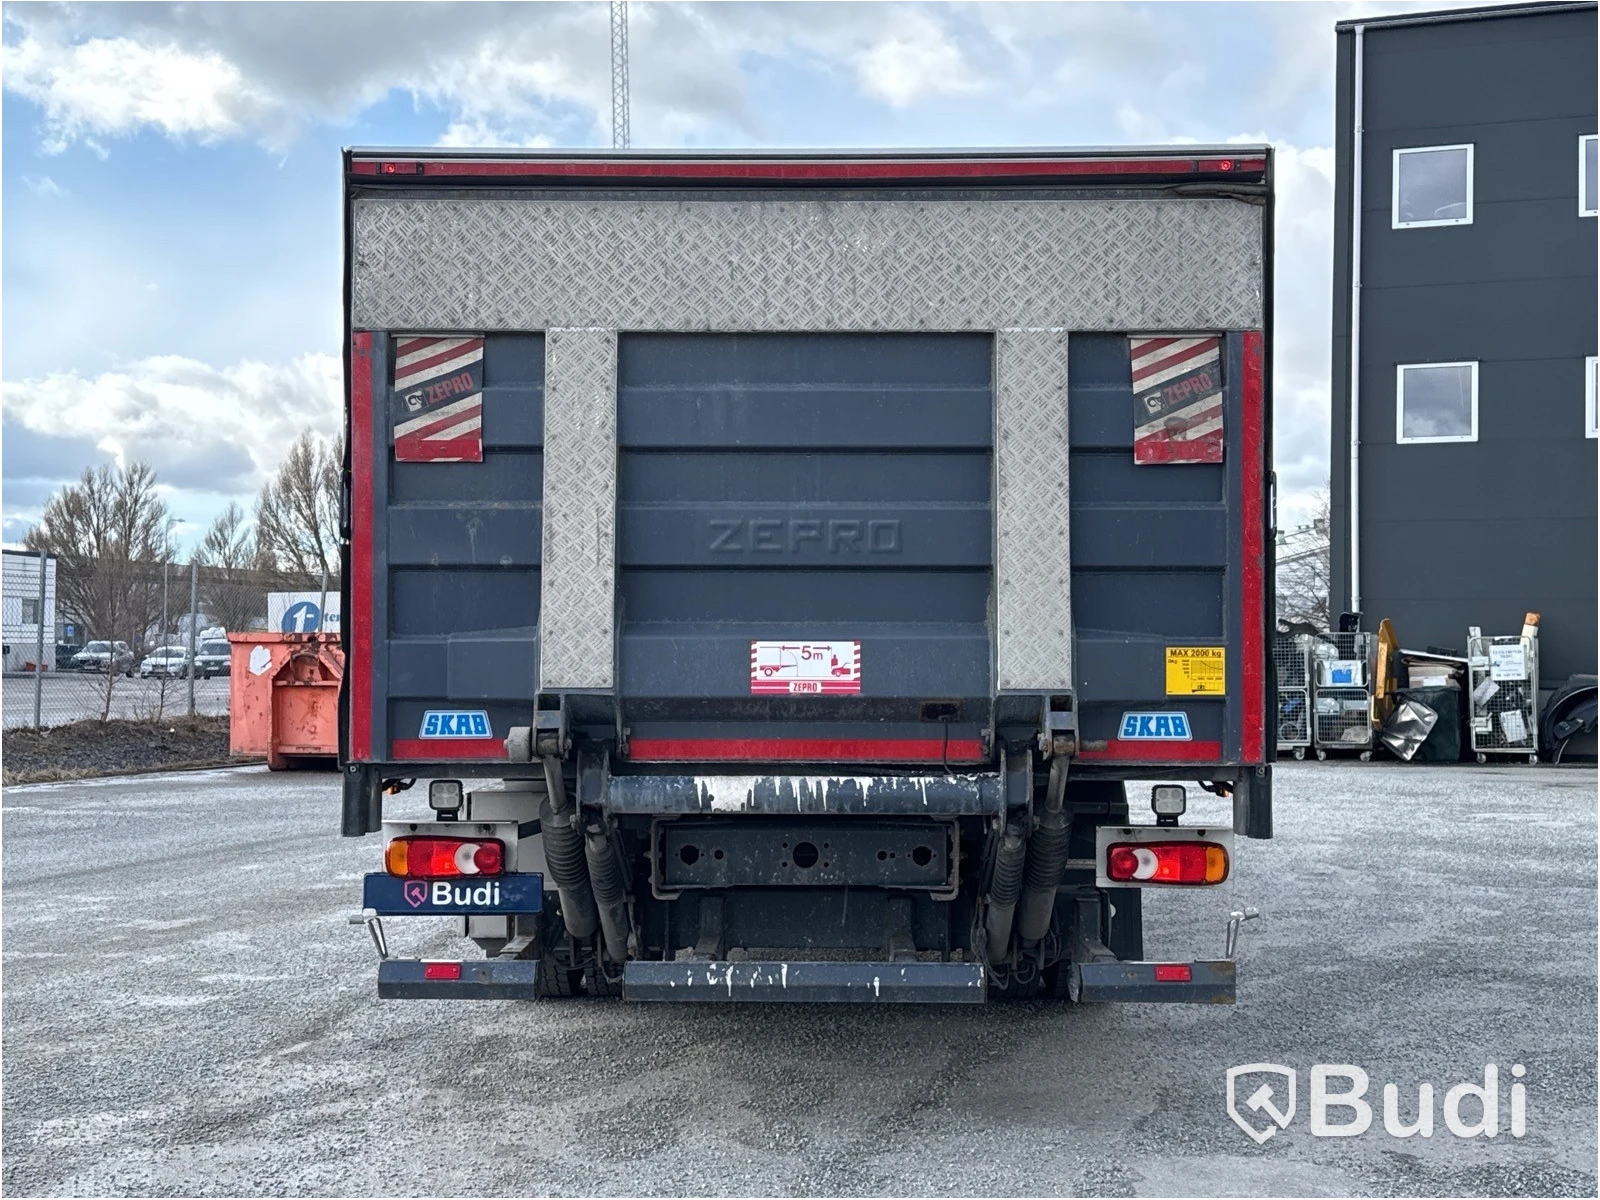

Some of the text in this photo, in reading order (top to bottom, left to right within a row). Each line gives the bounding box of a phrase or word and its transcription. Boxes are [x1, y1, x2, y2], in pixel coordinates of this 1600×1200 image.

[425, 372, 474, 404] ZEPRO
[1164, 372, 1214, 405] ZEPRO
[709, 519, 903, 553] ZEPRO
[1170, 649, 1222, 658] MAX 2000 kg
[793, 682, 818, 692] ZEPRO
[425, 714, 487, 735] SKAB
[1123, 716, 1187, 736] SKAB
[432, 881, 500, 906] Budi
